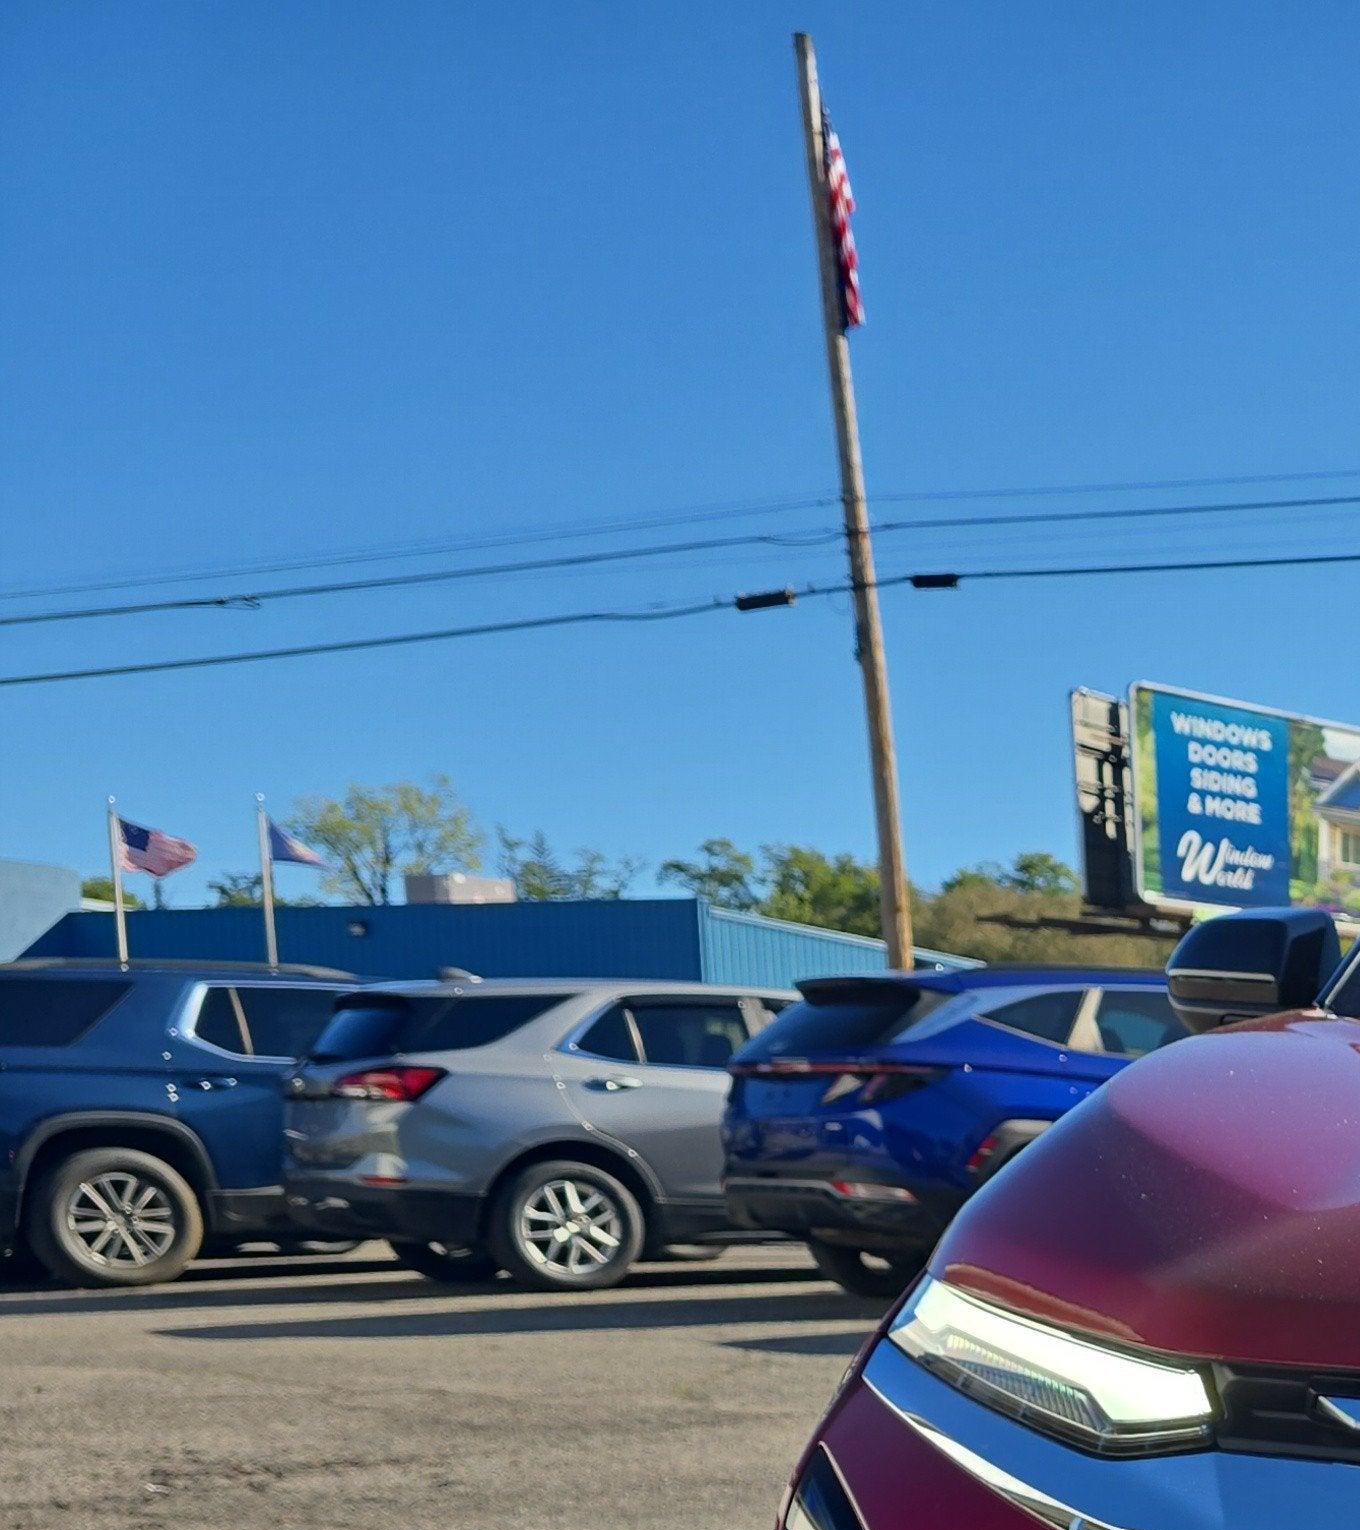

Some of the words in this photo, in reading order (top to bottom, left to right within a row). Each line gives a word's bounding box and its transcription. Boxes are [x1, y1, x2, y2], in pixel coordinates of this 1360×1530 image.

[1170, 711, 1272, 751] WINDOWS
[1188, 740, 1258, 774] DOORS
[1190, 767, 1258, 799] SIDING
[1187, 792, 1203, 816] &
[1204, 794, 1262, 825] MORE
